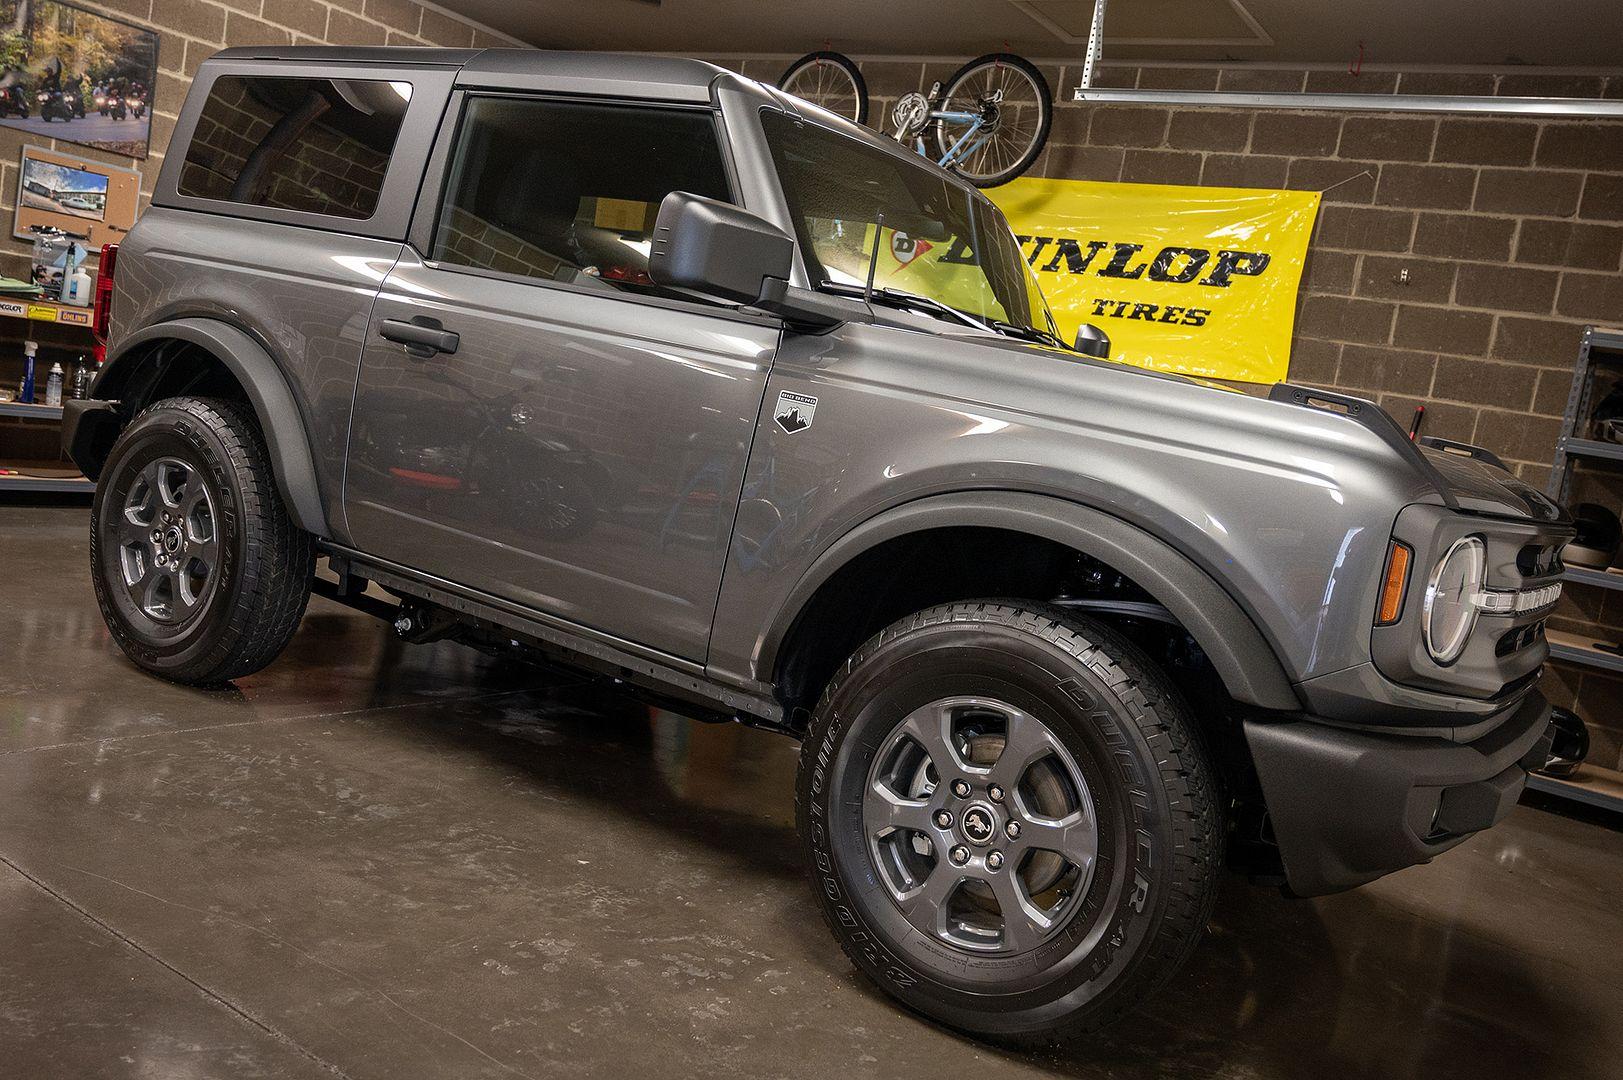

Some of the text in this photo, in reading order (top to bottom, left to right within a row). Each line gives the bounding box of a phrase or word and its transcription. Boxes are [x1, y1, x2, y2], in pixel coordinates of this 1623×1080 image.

[895, 238, 915, 253] D
[1091, 298, 1212, 327] TIRES
[795, 395, 816, 404] BEND
[1054, 675, 1155, 914] DUELER
[808, 710, 919, 991] BRIDGESTONE
